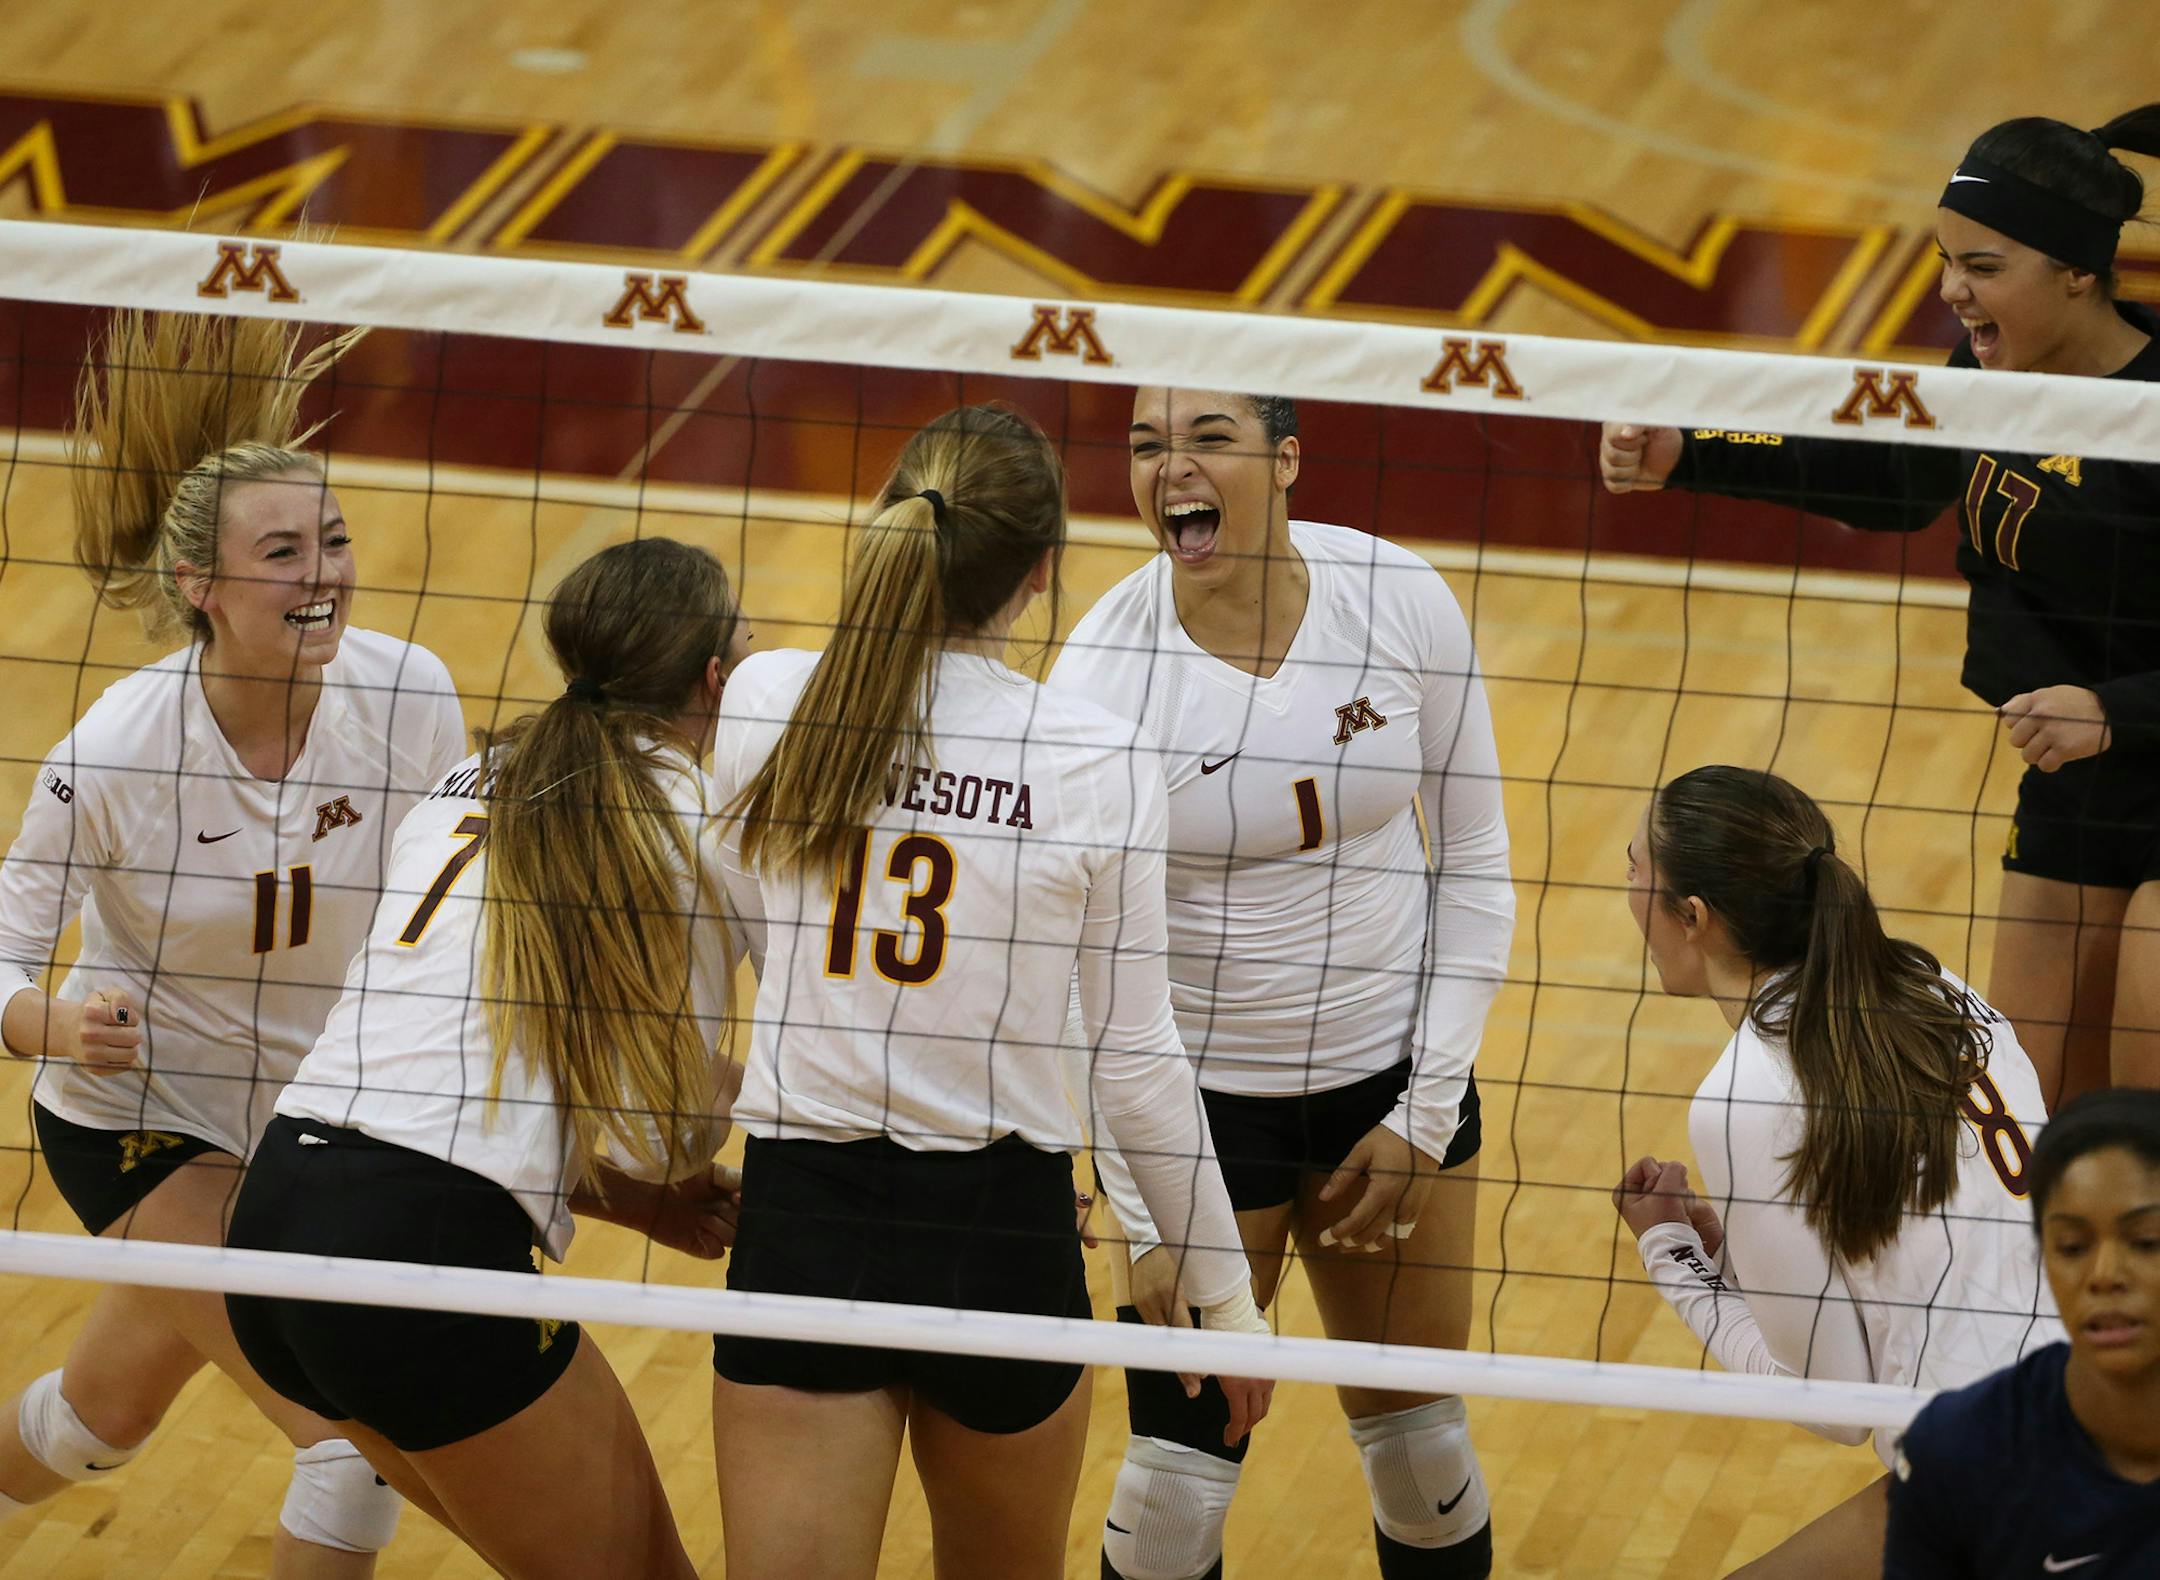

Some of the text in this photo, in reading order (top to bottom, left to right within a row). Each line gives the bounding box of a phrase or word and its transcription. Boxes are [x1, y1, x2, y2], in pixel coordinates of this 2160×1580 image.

[197, 240, 299, 304] M
[602, 271, 705, 335] M
[1010, 304, 1114, 367] M
[1421, 336, 1523, 401] M
[1832, 366, 1936, 430] M
[1966, 453, 2041, 572] 17
[1333, 696, 1388, 745] M
[312, 795, 363, 842] M
[1291, 775, 1326, 851] 1
[253, 864, 312, 954] 11
[395, 812, 491, 947] 7
[823, 826, 958, 988] 13
[1958, 1062, 2034, 1200] 8
